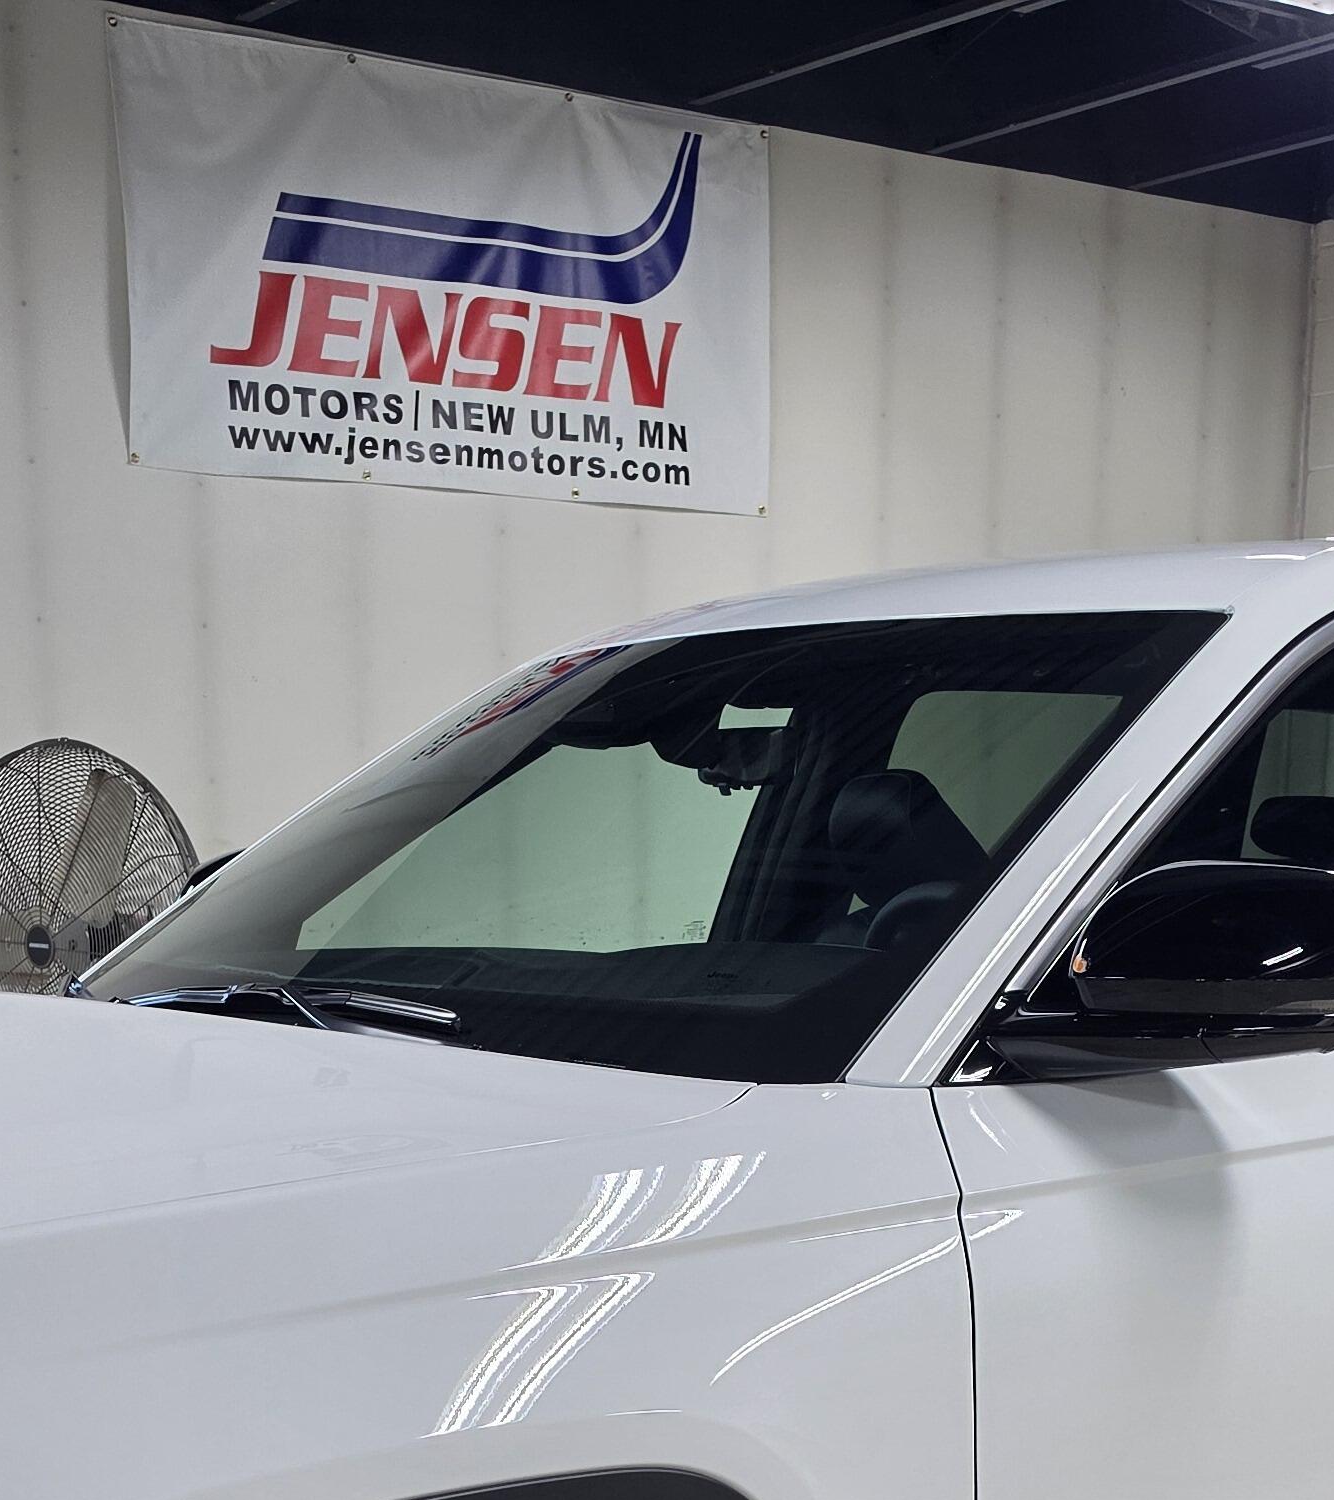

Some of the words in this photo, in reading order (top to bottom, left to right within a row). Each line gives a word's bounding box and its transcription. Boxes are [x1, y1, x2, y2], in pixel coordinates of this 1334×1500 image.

[210, 270, 683, 409] JENSEN
[228, 380, 404, 425] MOTORS
[432, 399, 516, 436] NEW
[530, 409, 624, 452] ULM,
[639, 420, 688, 453] MN
[228, 425, 691, 486] www.jensenmotors.com
